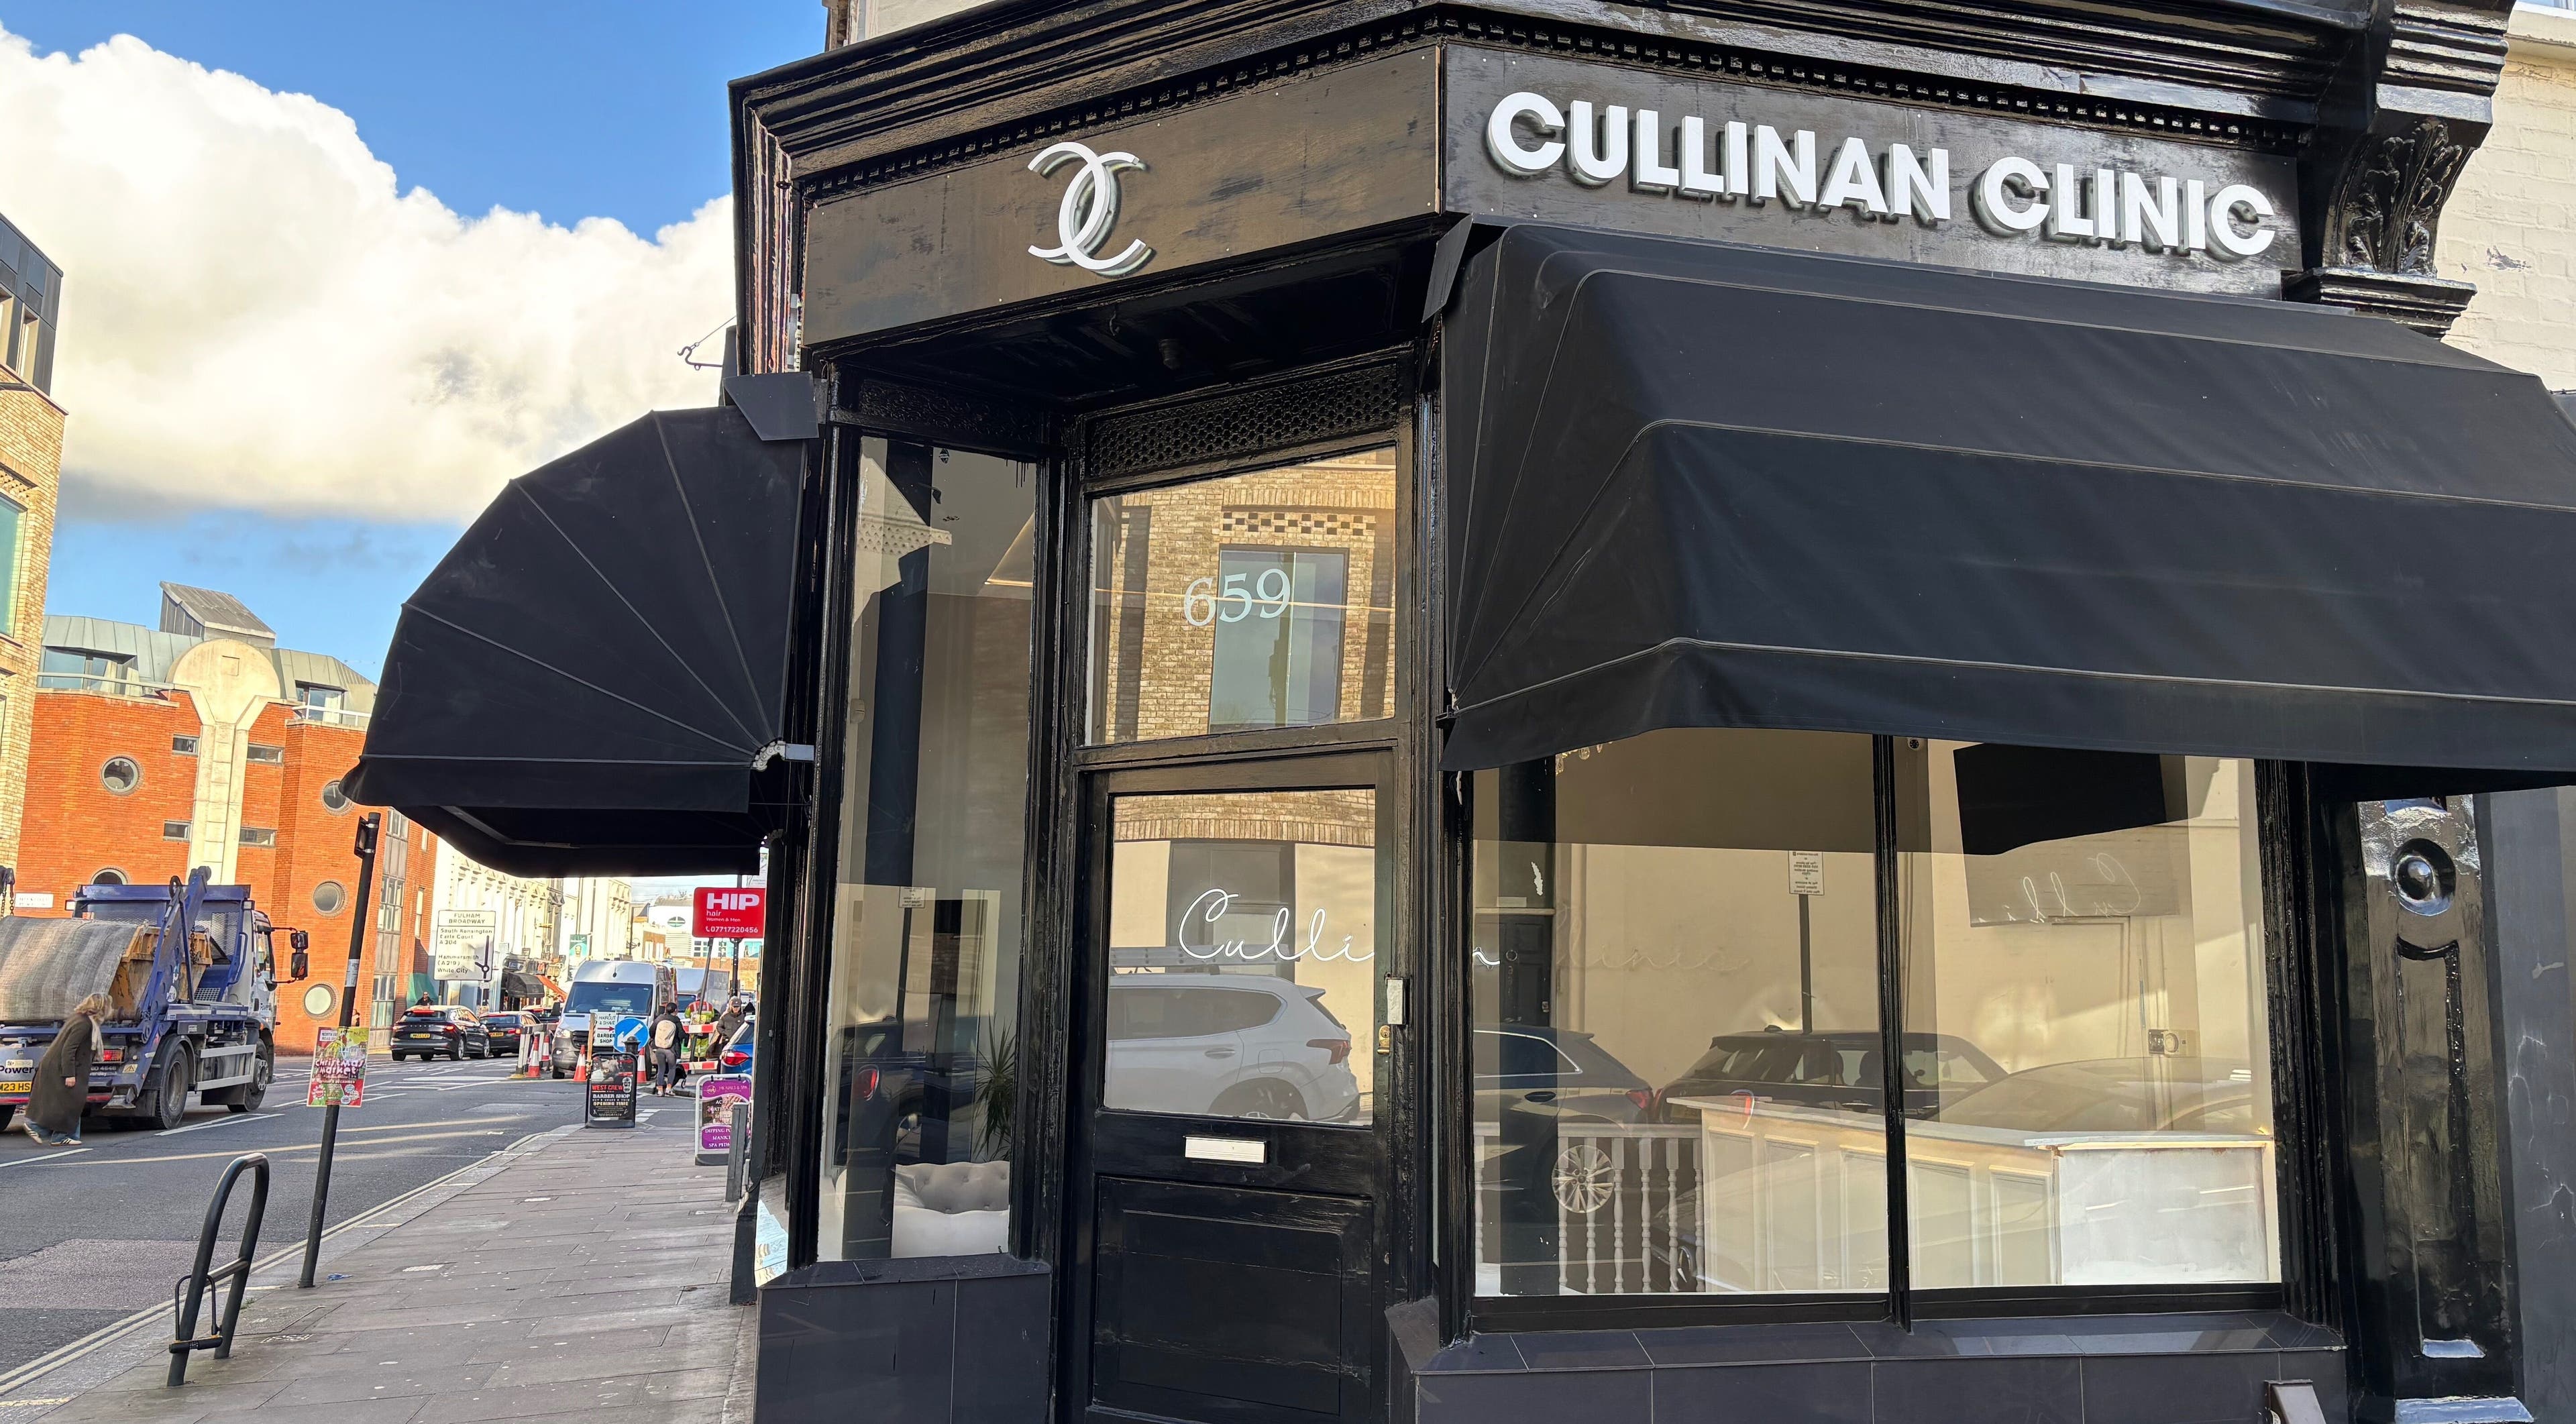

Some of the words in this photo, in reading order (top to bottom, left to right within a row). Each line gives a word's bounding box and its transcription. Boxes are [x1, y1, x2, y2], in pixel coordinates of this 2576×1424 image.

[1485, 91, 1951, 222] CULLINAN
[1974, 156, 2277, 258] CLINIC
[1183, 568, 1292, 626] 659
[706, 893, 759, 910] HIP
